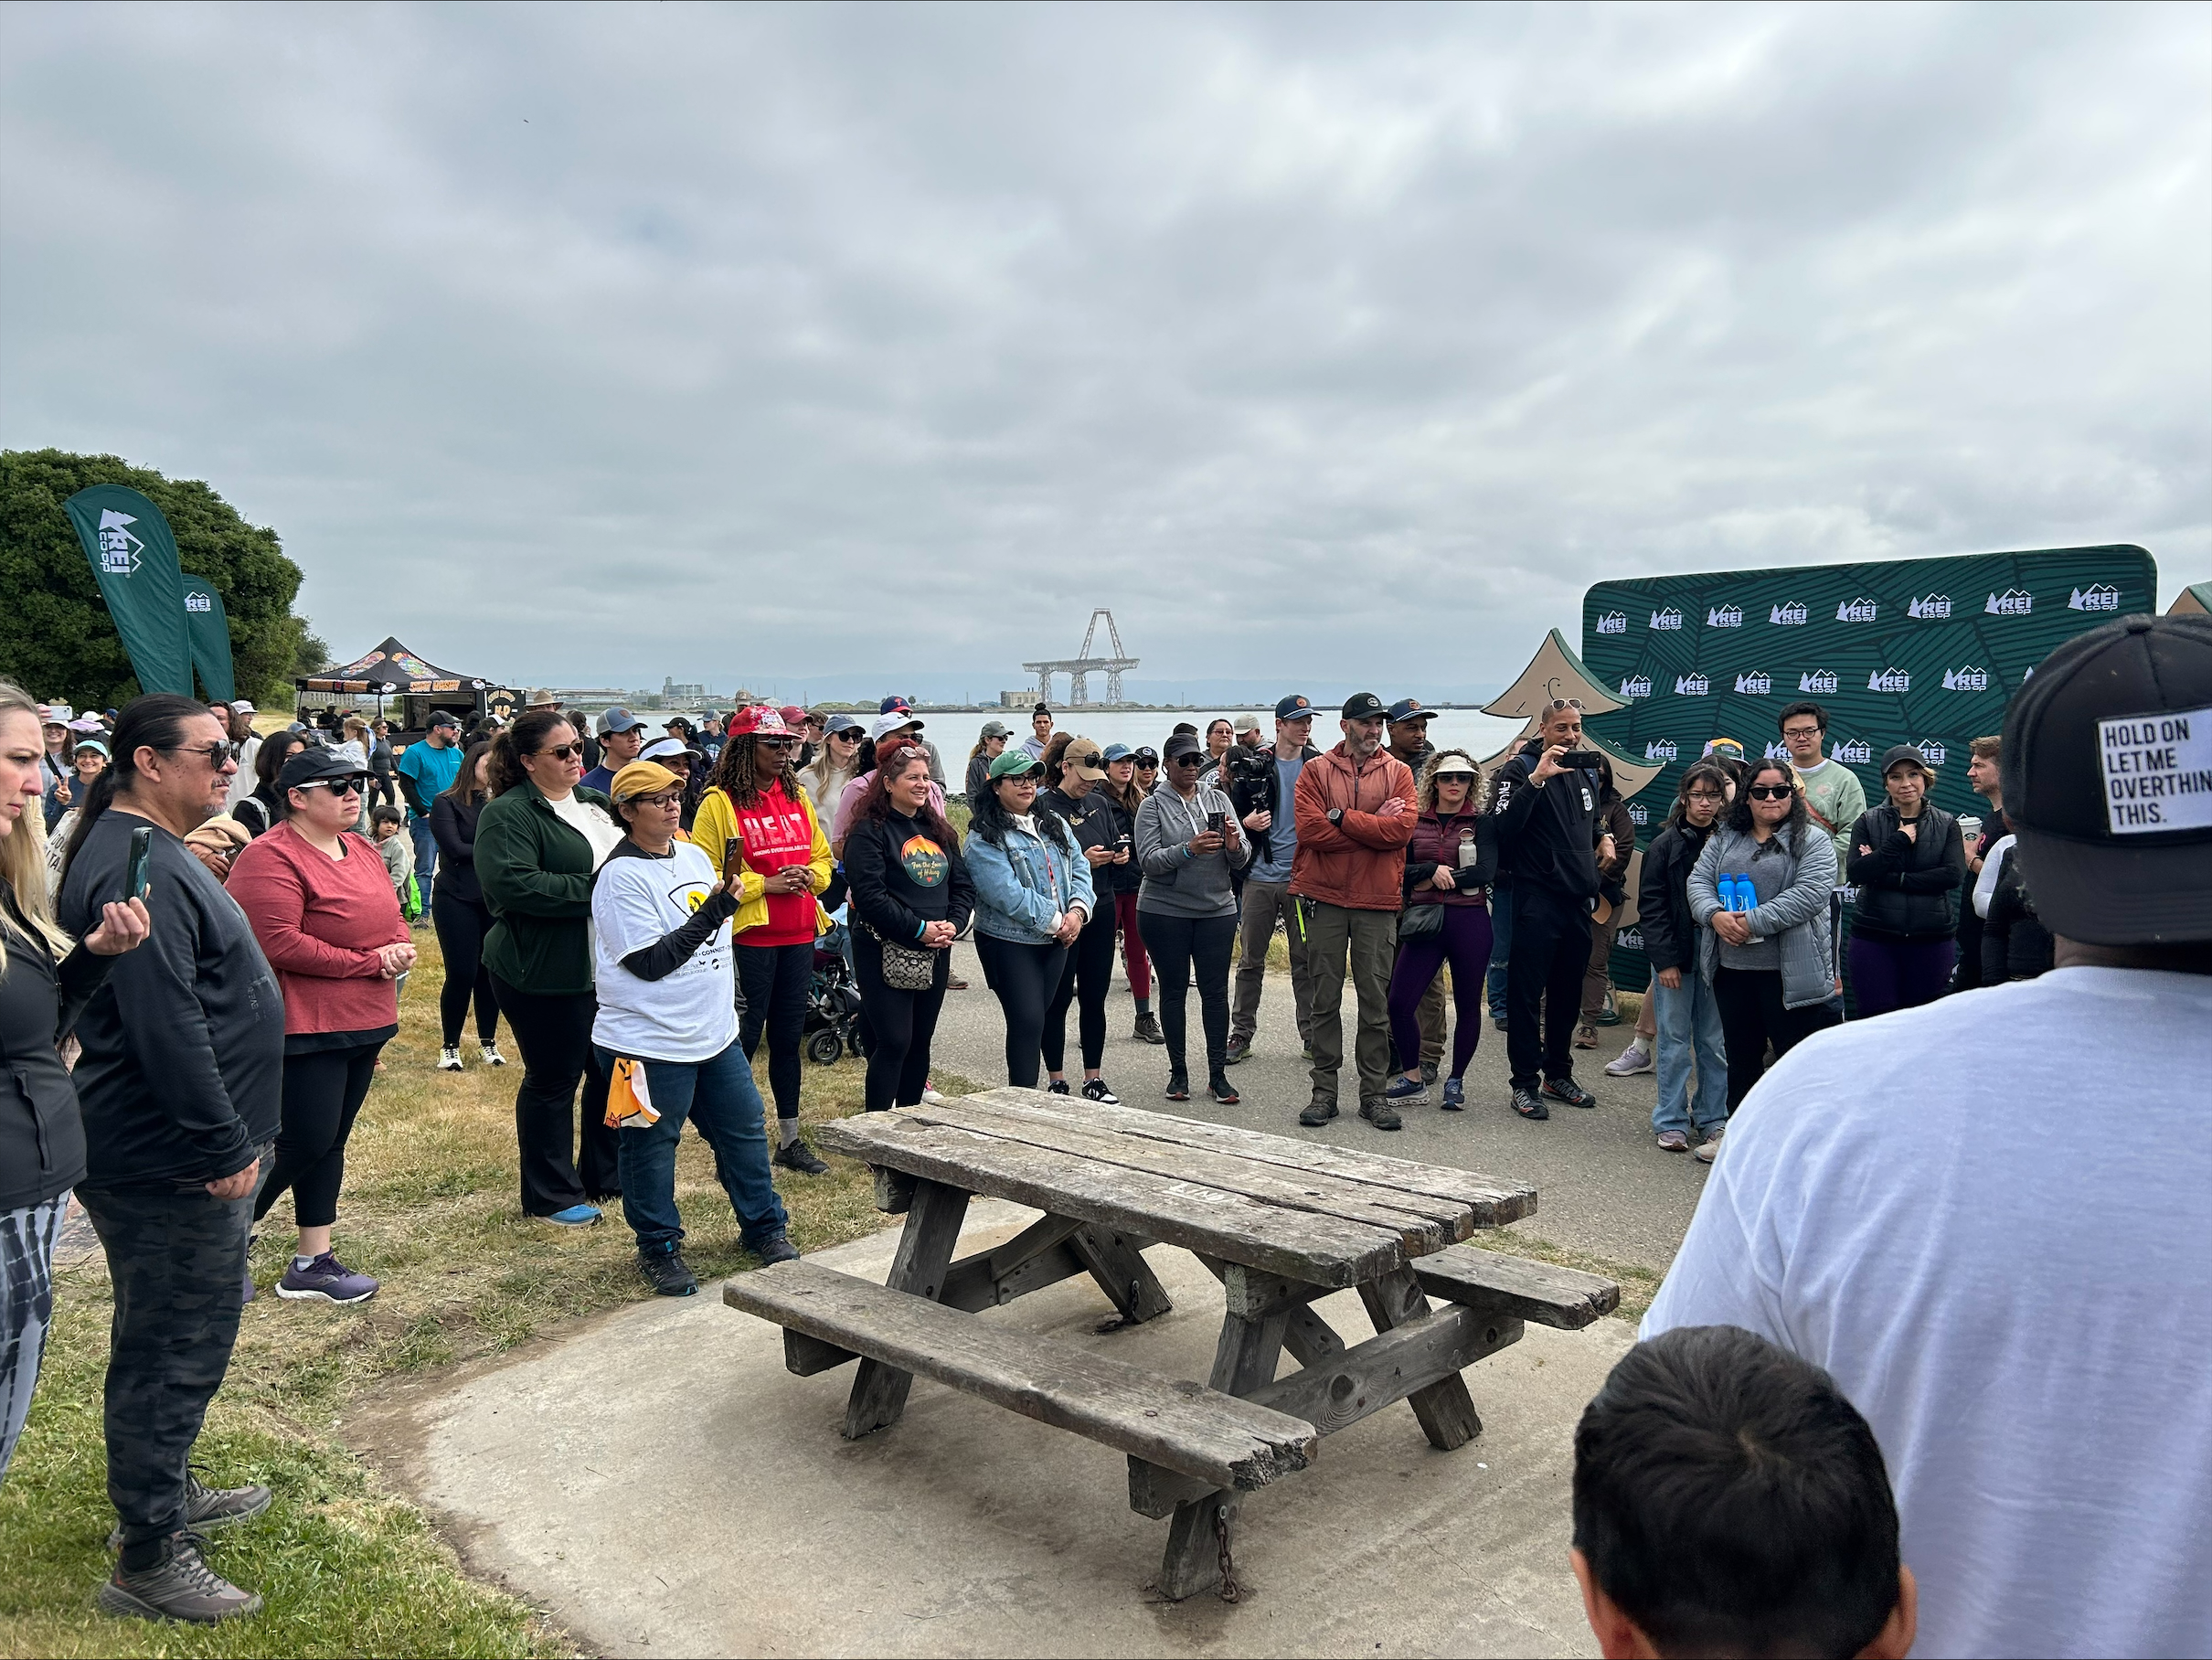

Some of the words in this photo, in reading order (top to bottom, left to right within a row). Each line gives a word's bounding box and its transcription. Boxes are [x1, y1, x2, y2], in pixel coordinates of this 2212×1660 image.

[108, 532, 130, 573] REI
[186, 598, 211, 608] REI
[2001, 596, 2031, 609] REI
[2086, 591, 2119, 605] REI
[1850, 605, 1876, 616] REI
[1922, 601, 1951, 612] REI
[1660, 614, 1682, 625] REI
[1717, 612, 1742, 622] REI
[1782, 609, 1807, 620] REI
[1606, 618, 1626, 629] REI
[1747, 678, 1771, 689] REI
[1812, 676, 1837, 687] REI
[1882, 675, 1909, 687] REI
[1958, 673, 1987, 686] REI
[1631, 682, 1651, 693] REI
[1686, 680, 1708, 691] REI
[2105, 723, 2157, 748] HOLD
[2161, 718, 2190, 742] ON
[1655, 746, 1676, 757] REI
[1844, 748, 1870, 759] REI
[2107, 750, 2143, 774] LET
[2145, 747, 2177, 771] ME
[2113, 803, 2167, 825] THIS.
